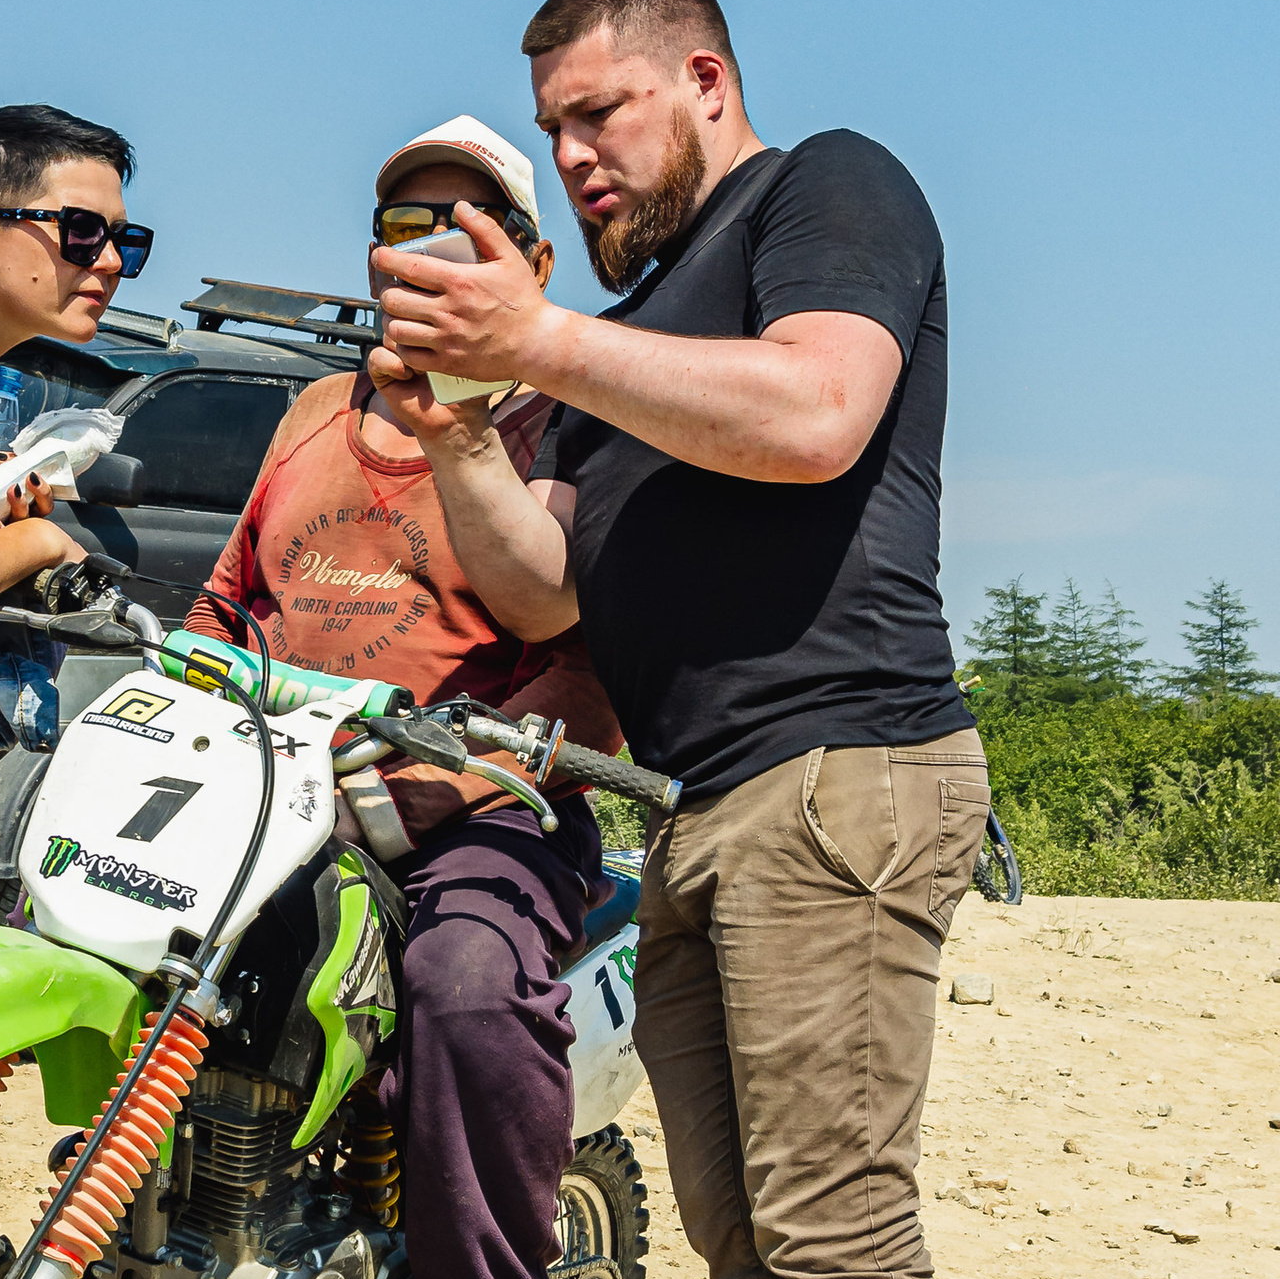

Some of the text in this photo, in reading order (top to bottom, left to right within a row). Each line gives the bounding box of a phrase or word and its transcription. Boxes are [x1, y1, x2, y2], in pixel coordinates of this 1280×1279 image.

[299, 550, 412, 597] Wrangler
[290, 597, 398, 615] NORTH CAROLINA
[321, 617, 353, 632] 1947
[117, 720, 173, 741] RACING
[116, 776, 204, 843] 1
[85, 875, 169, 910] ENERGY
[594, 964, 625, 1031] 1
